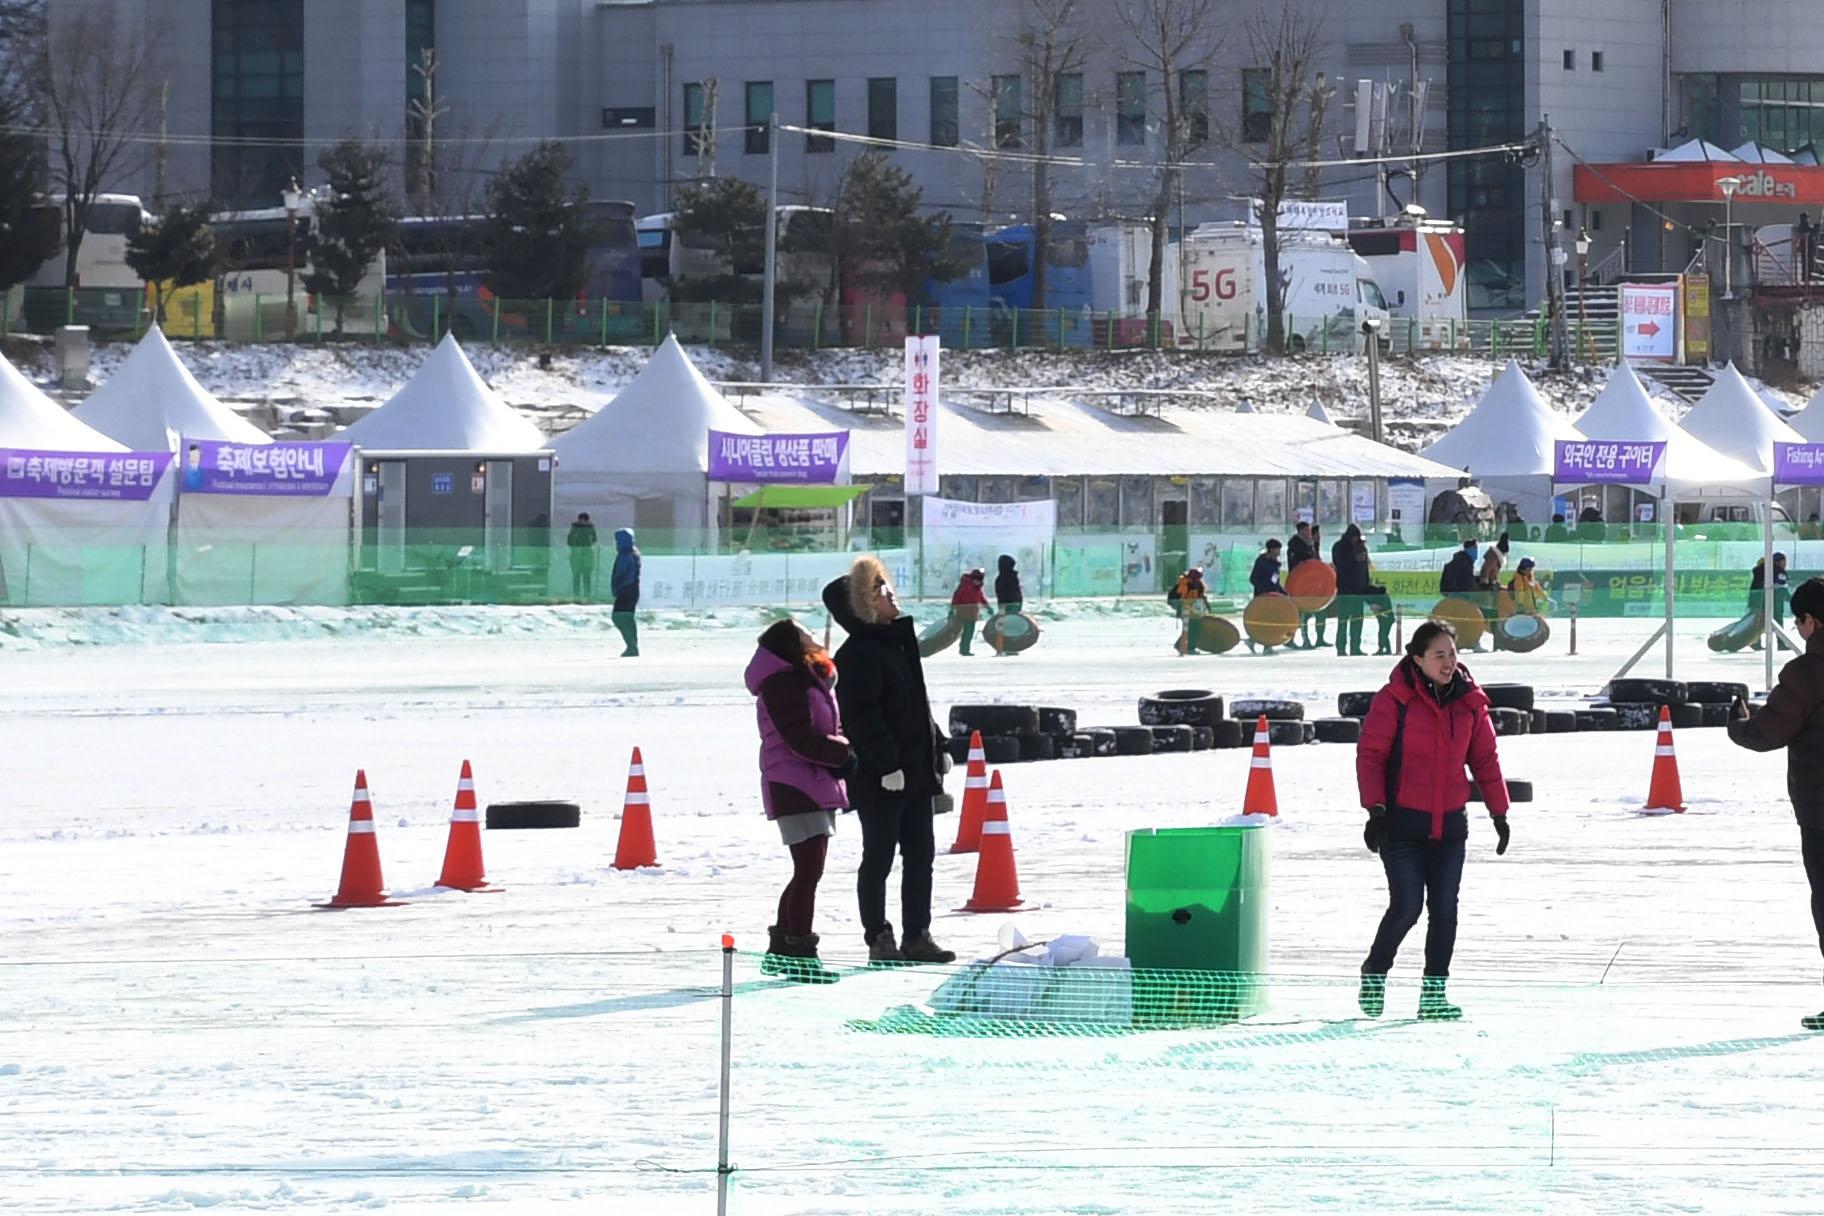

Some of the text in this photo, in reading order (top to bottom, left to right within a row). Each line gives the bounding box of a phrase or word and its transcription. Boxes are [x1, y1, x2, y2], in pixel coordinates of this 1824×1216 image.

[1191, 268, 1236, 302] 5G
[1339, 283, 1350, 296] 5G
[913, 372, 930, 450] 화장실
[217, 446, 325, 479] 축제보험안내
[721, 436, 838, 467] 시니어클럽 생산품 판매
[1563, 444, 1654, 470] 외국인 전용 구이터
[1786, 447, 1814, 469] Fishing
[26, 456, 155, 486] 축제방문객 설문팀
